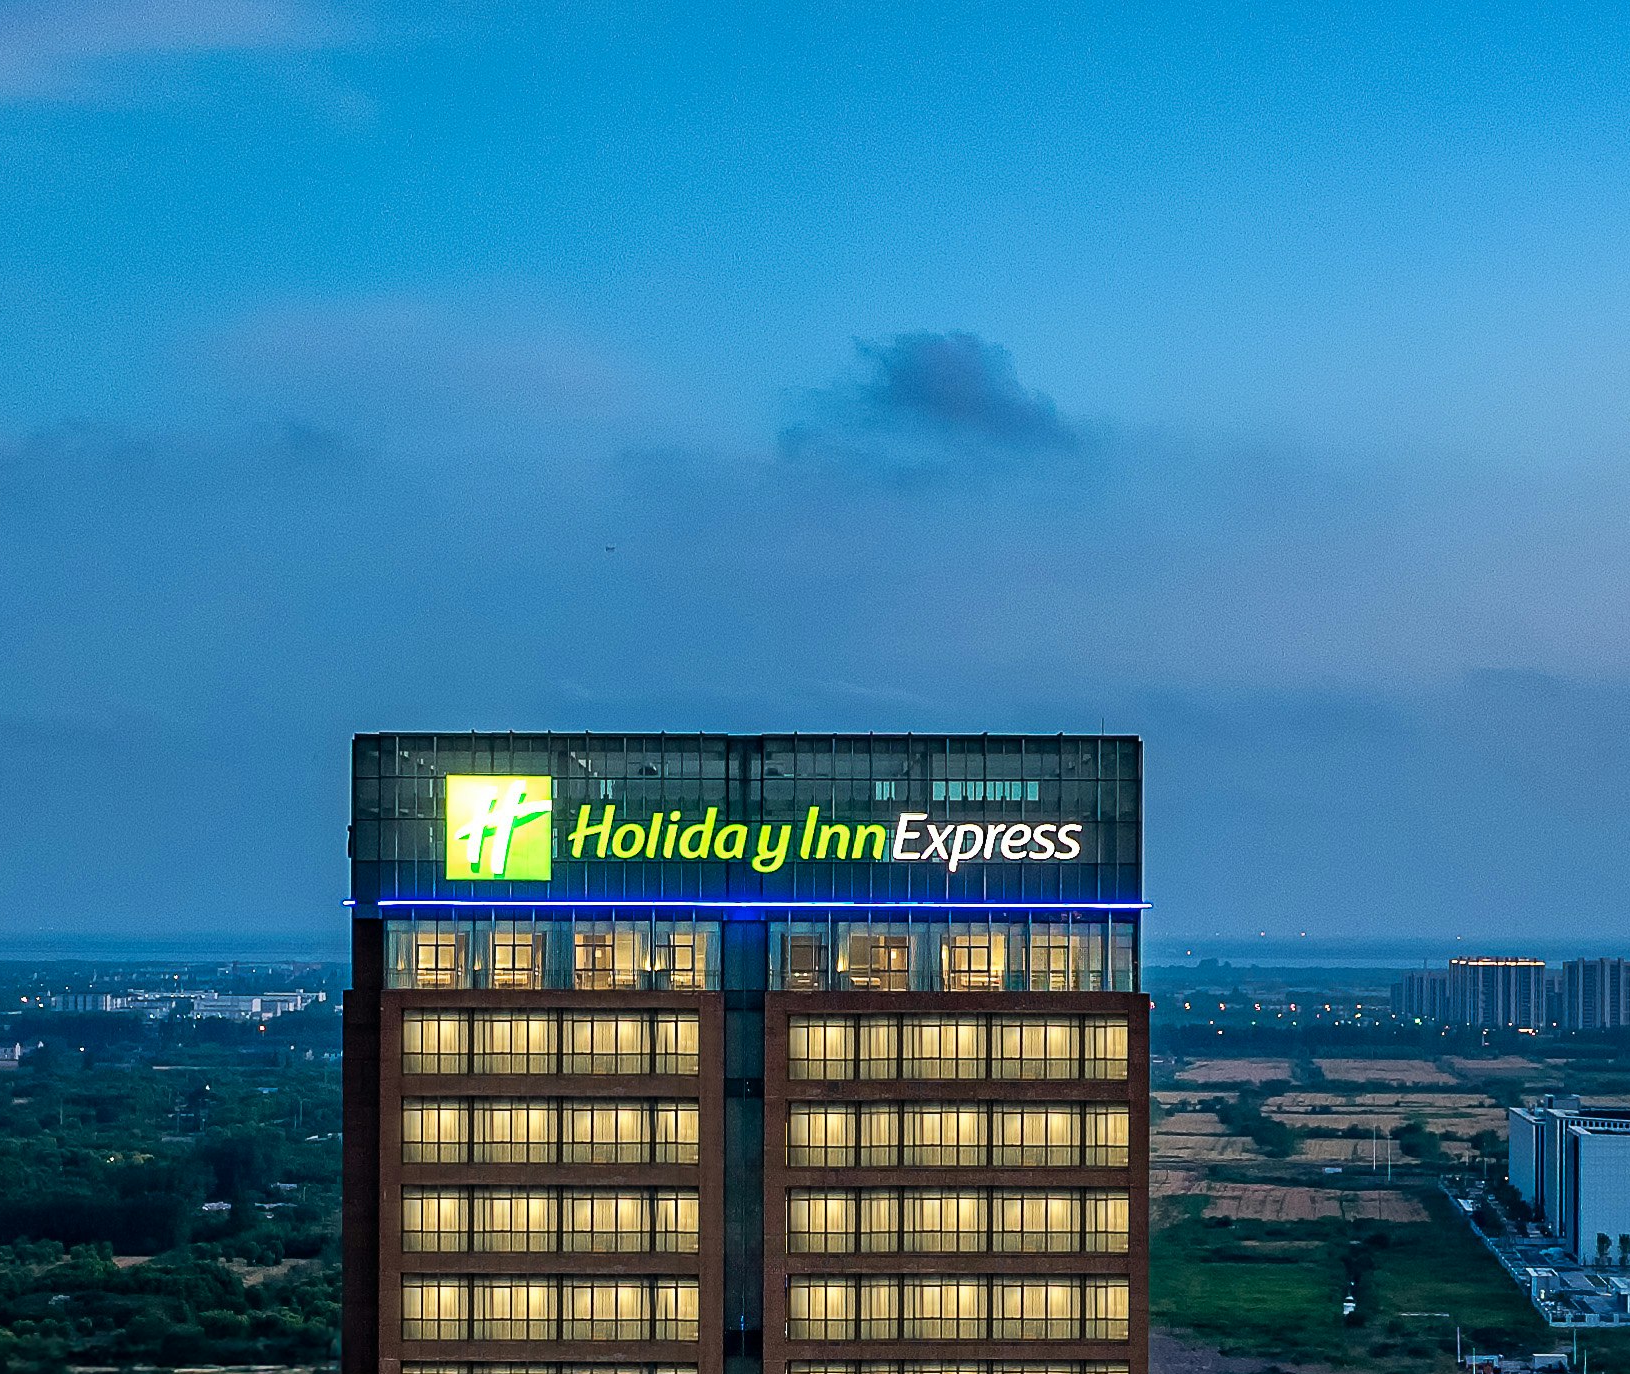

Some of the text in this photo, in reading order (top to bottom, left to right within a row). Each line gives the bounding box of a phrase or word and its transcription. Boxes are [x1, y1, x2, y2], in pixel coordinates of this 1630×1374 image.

[567, 804, 1083, 873] Holiday Inn Express
